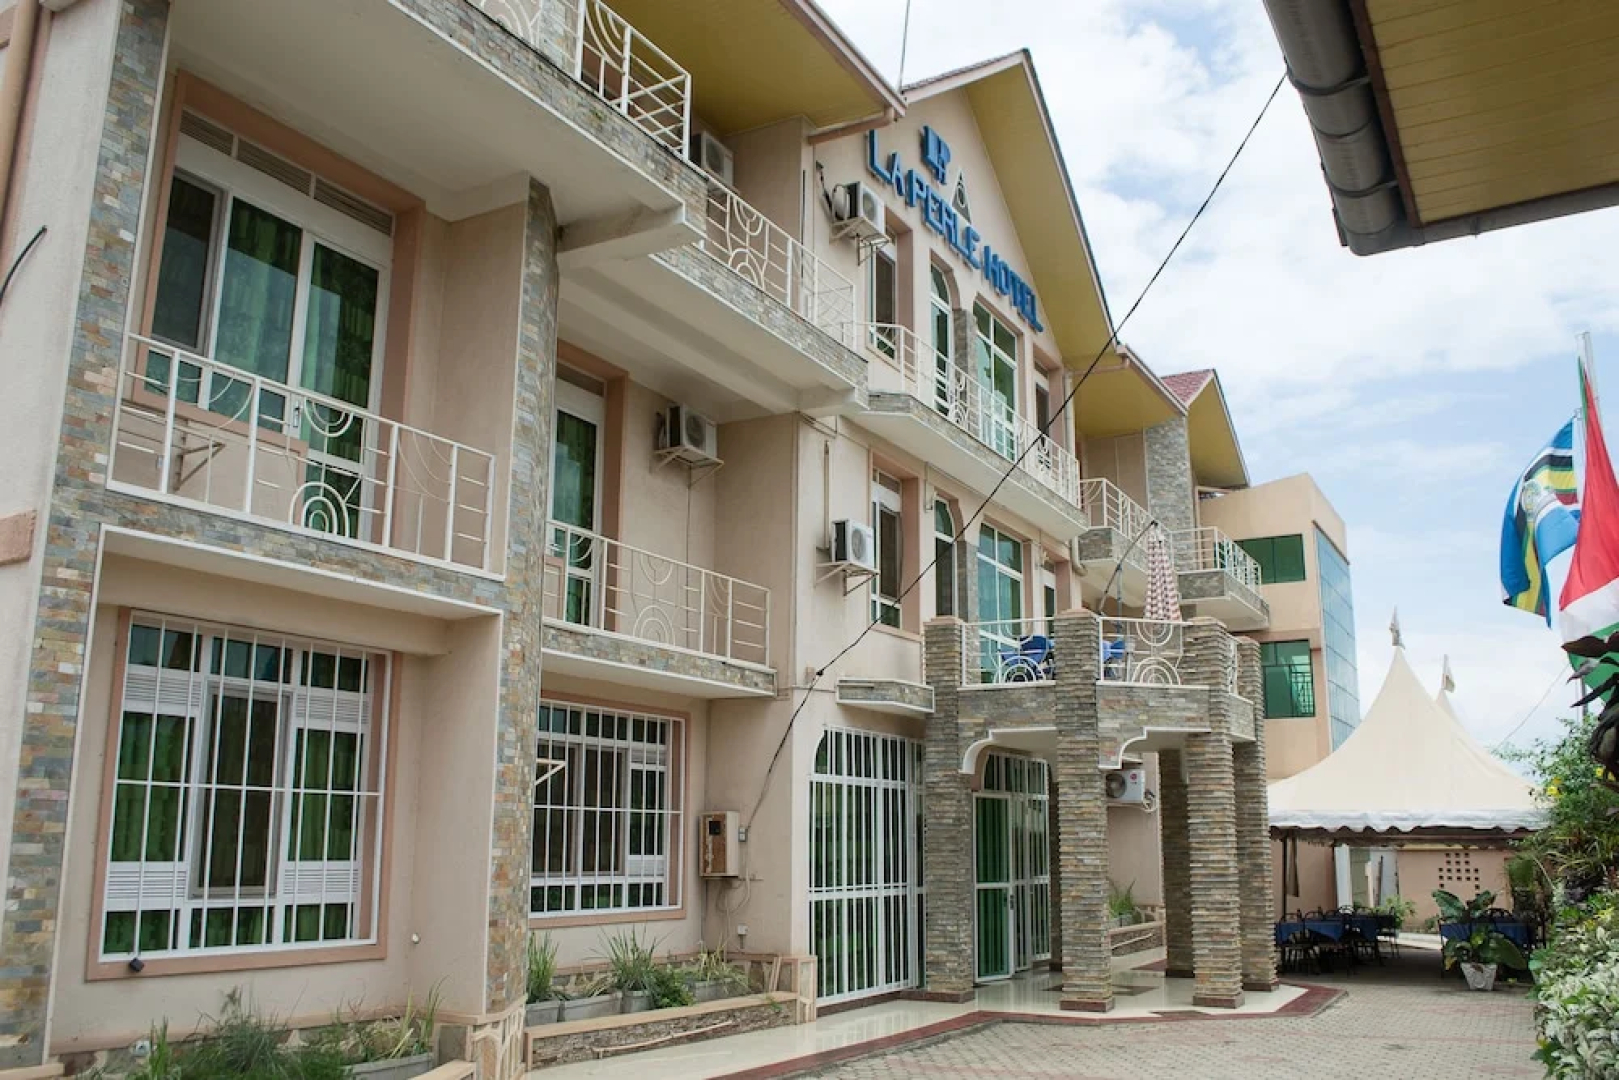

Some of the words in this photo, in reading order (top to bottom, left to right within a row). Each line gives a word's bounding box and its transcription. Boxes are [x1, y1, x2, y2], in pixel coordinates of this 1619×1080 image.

[867, 129, 904, 197] LA
[906, 169, 981, 270] PERLE
[983, 245, 1044, 332] HOTEL
